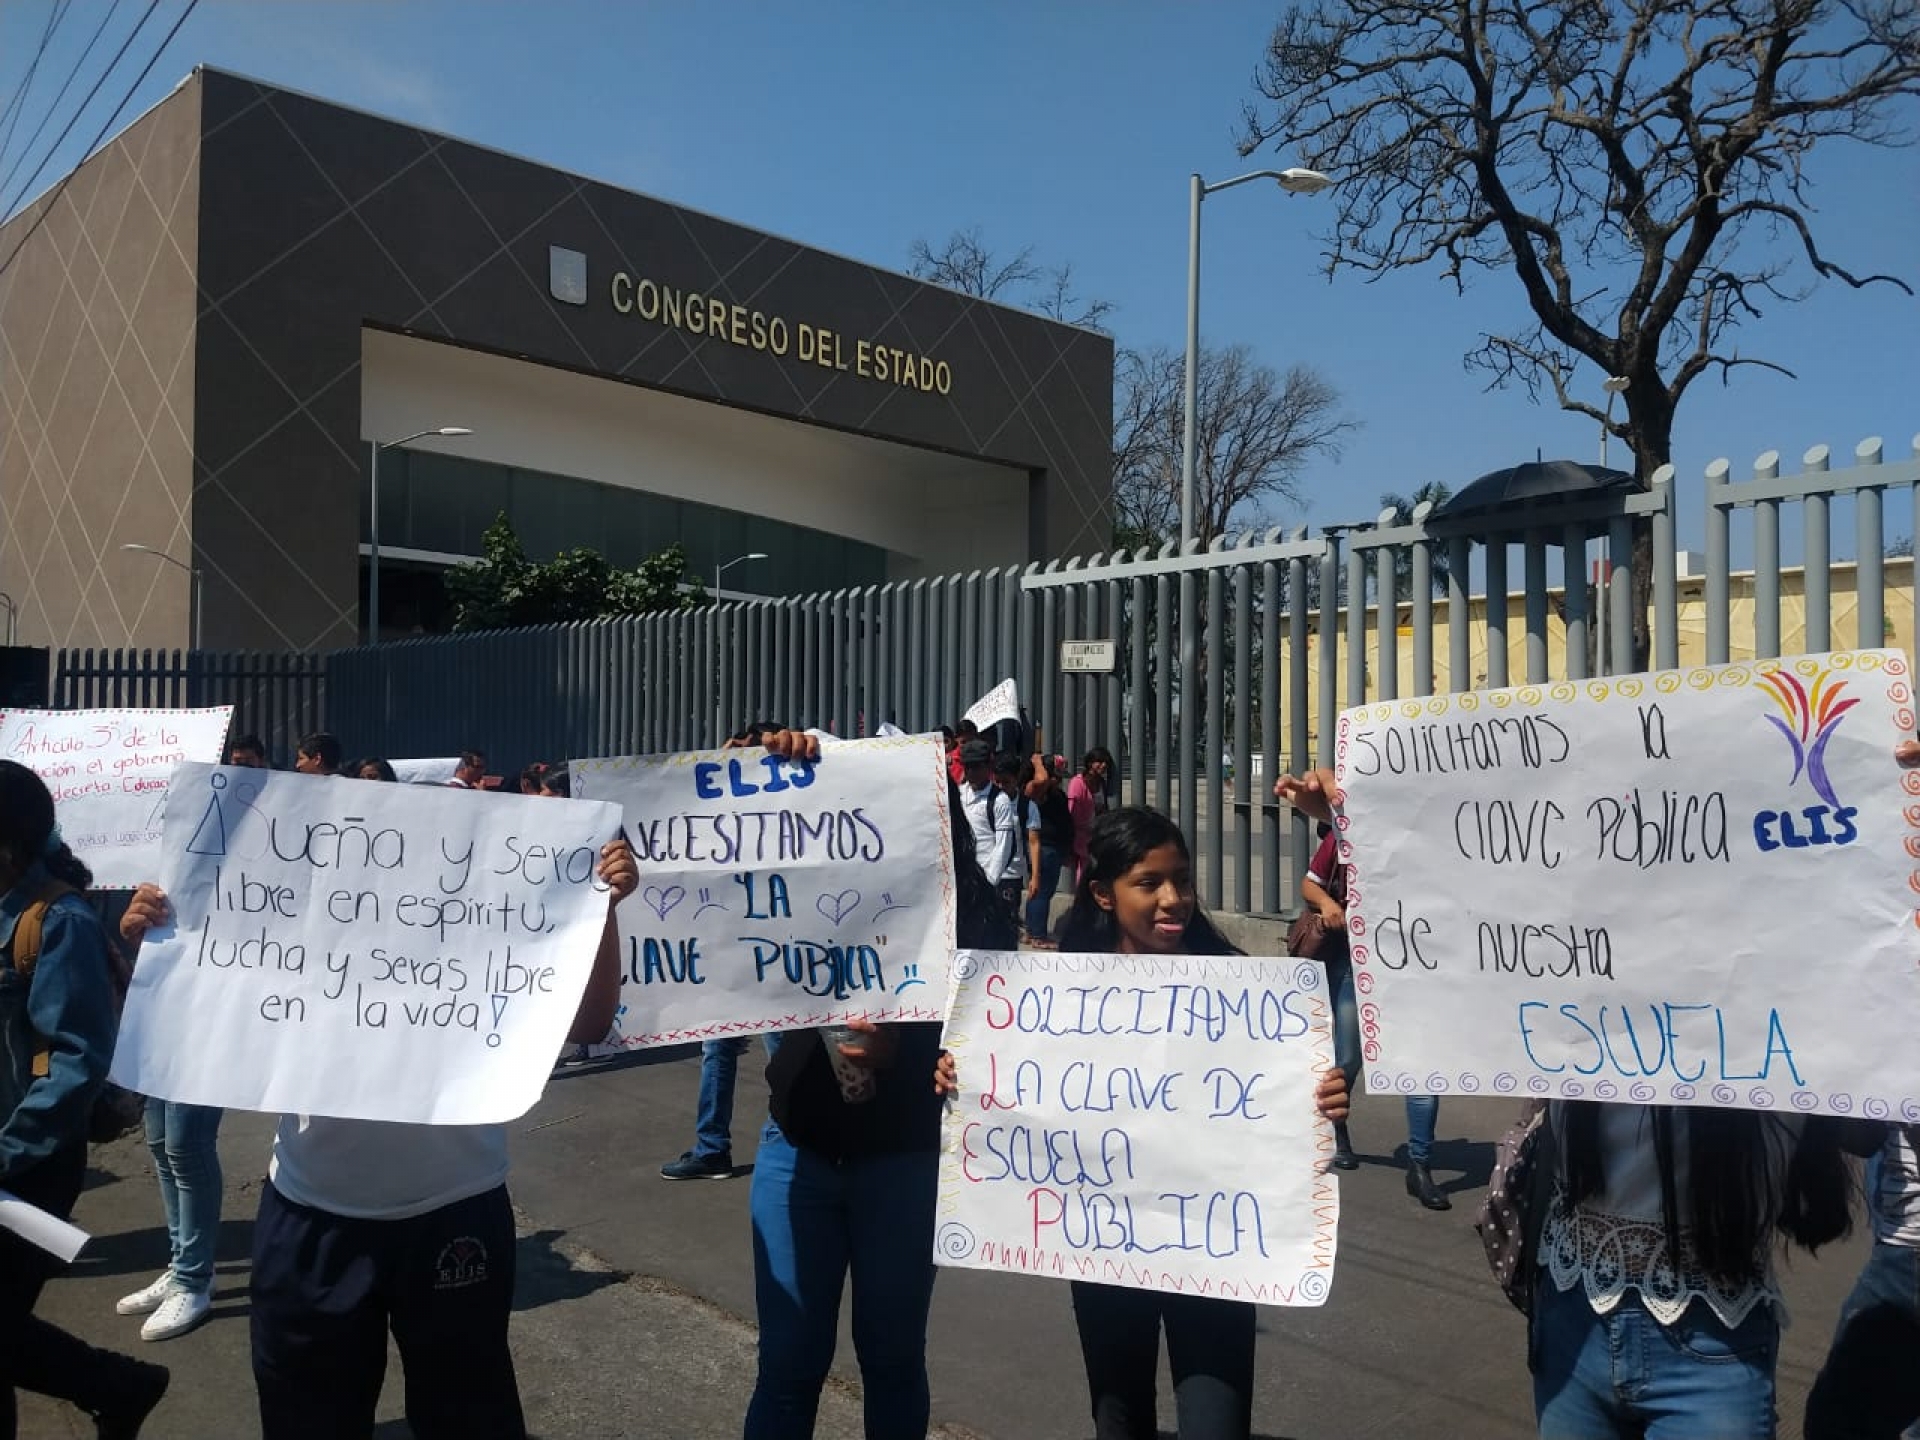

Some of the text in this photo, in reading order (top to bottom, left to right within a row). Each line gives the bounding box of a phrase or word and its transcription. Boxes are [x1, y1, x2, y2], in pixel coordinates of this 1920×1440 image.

[611, 272, 952, 395] CONGRESO DEL ESTADO
[122, 726, 146, 748] de
[161, 728, 178, 745] la
[86, 758, 103, 774] el
[695, 754, 822, 799] ELIS
[620, 808, 885, 864] NECESITAMOS
[1753, 805, 1858, 851] ELIS
[439, 837, 474, 893] y
[215, 866, 297, 917] libre
[328, 890, 379, 923] en
[198, 915, 305, 974] lucha
[323, 951, 350, 999] y
[485, 945, 556, 996] libre
[1375, 899, 1614, 980] de nuestra
[260, 994, 305, 1022] en
[356, 982, 387, 1027] la
[985, 974, 1309, 1042] SOLICITAMOS
[1519, 1001, 1806, 1086] ESCUELA
[980, 1053, 1266, 1120] LA CLAVE DE
[961, 1122, 1135, 1188] ESCUELA
